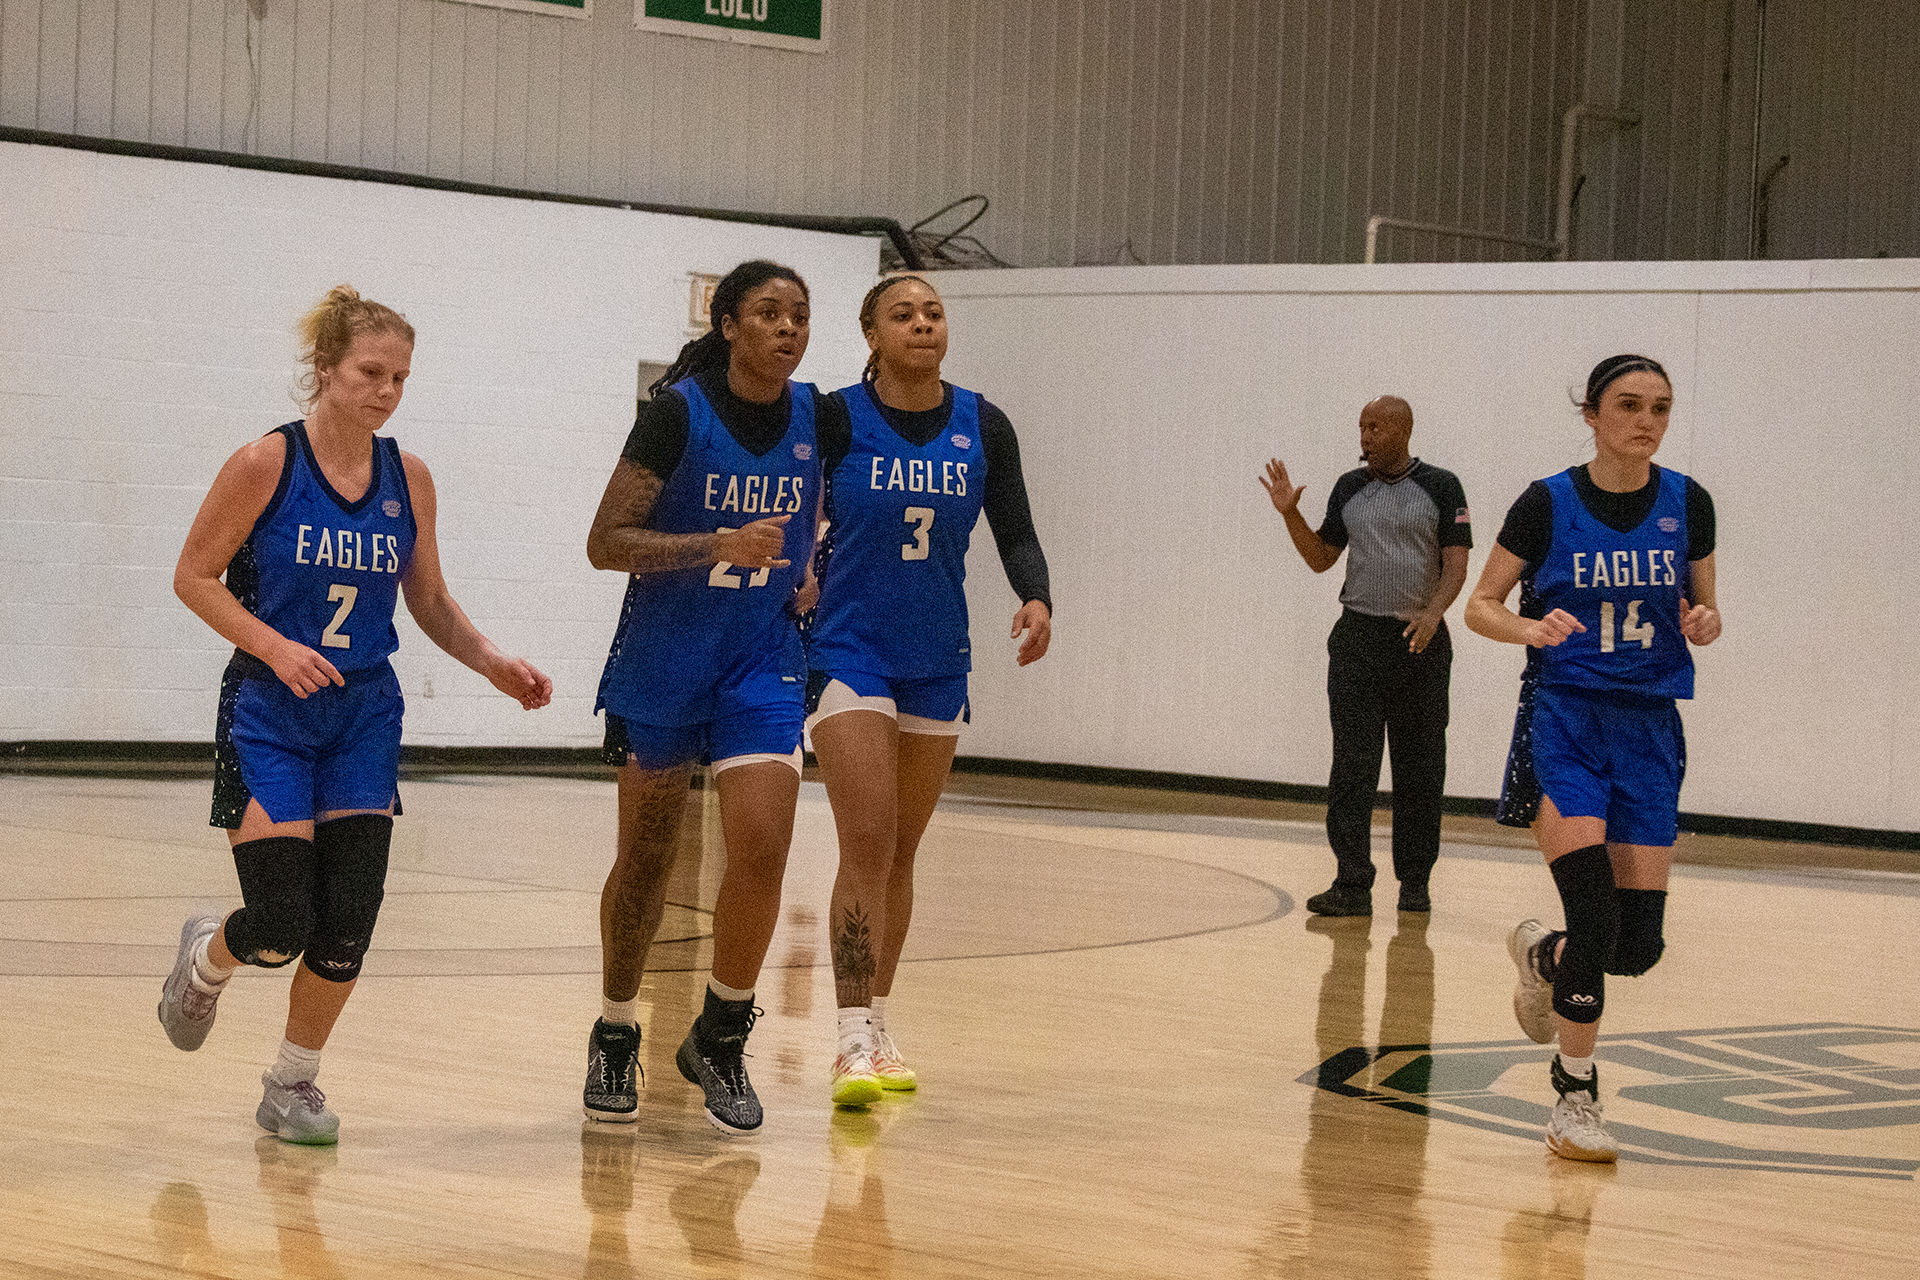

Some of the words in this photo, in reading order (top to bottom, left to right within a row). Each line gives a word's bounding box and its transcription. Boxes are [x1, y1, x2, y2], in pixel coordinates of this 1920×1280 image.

[704, 473, 803, 513] EAGLES
[870, 456, 968, 496] EAGLES
[295, 524, 399, 573] EAGLES
[901, 506, 935, 561] 3
[1572, 549, 1676, 589] EAGLES
[321, 584, 358, 649] 2
[1600, 600, 1655, 653] 14
